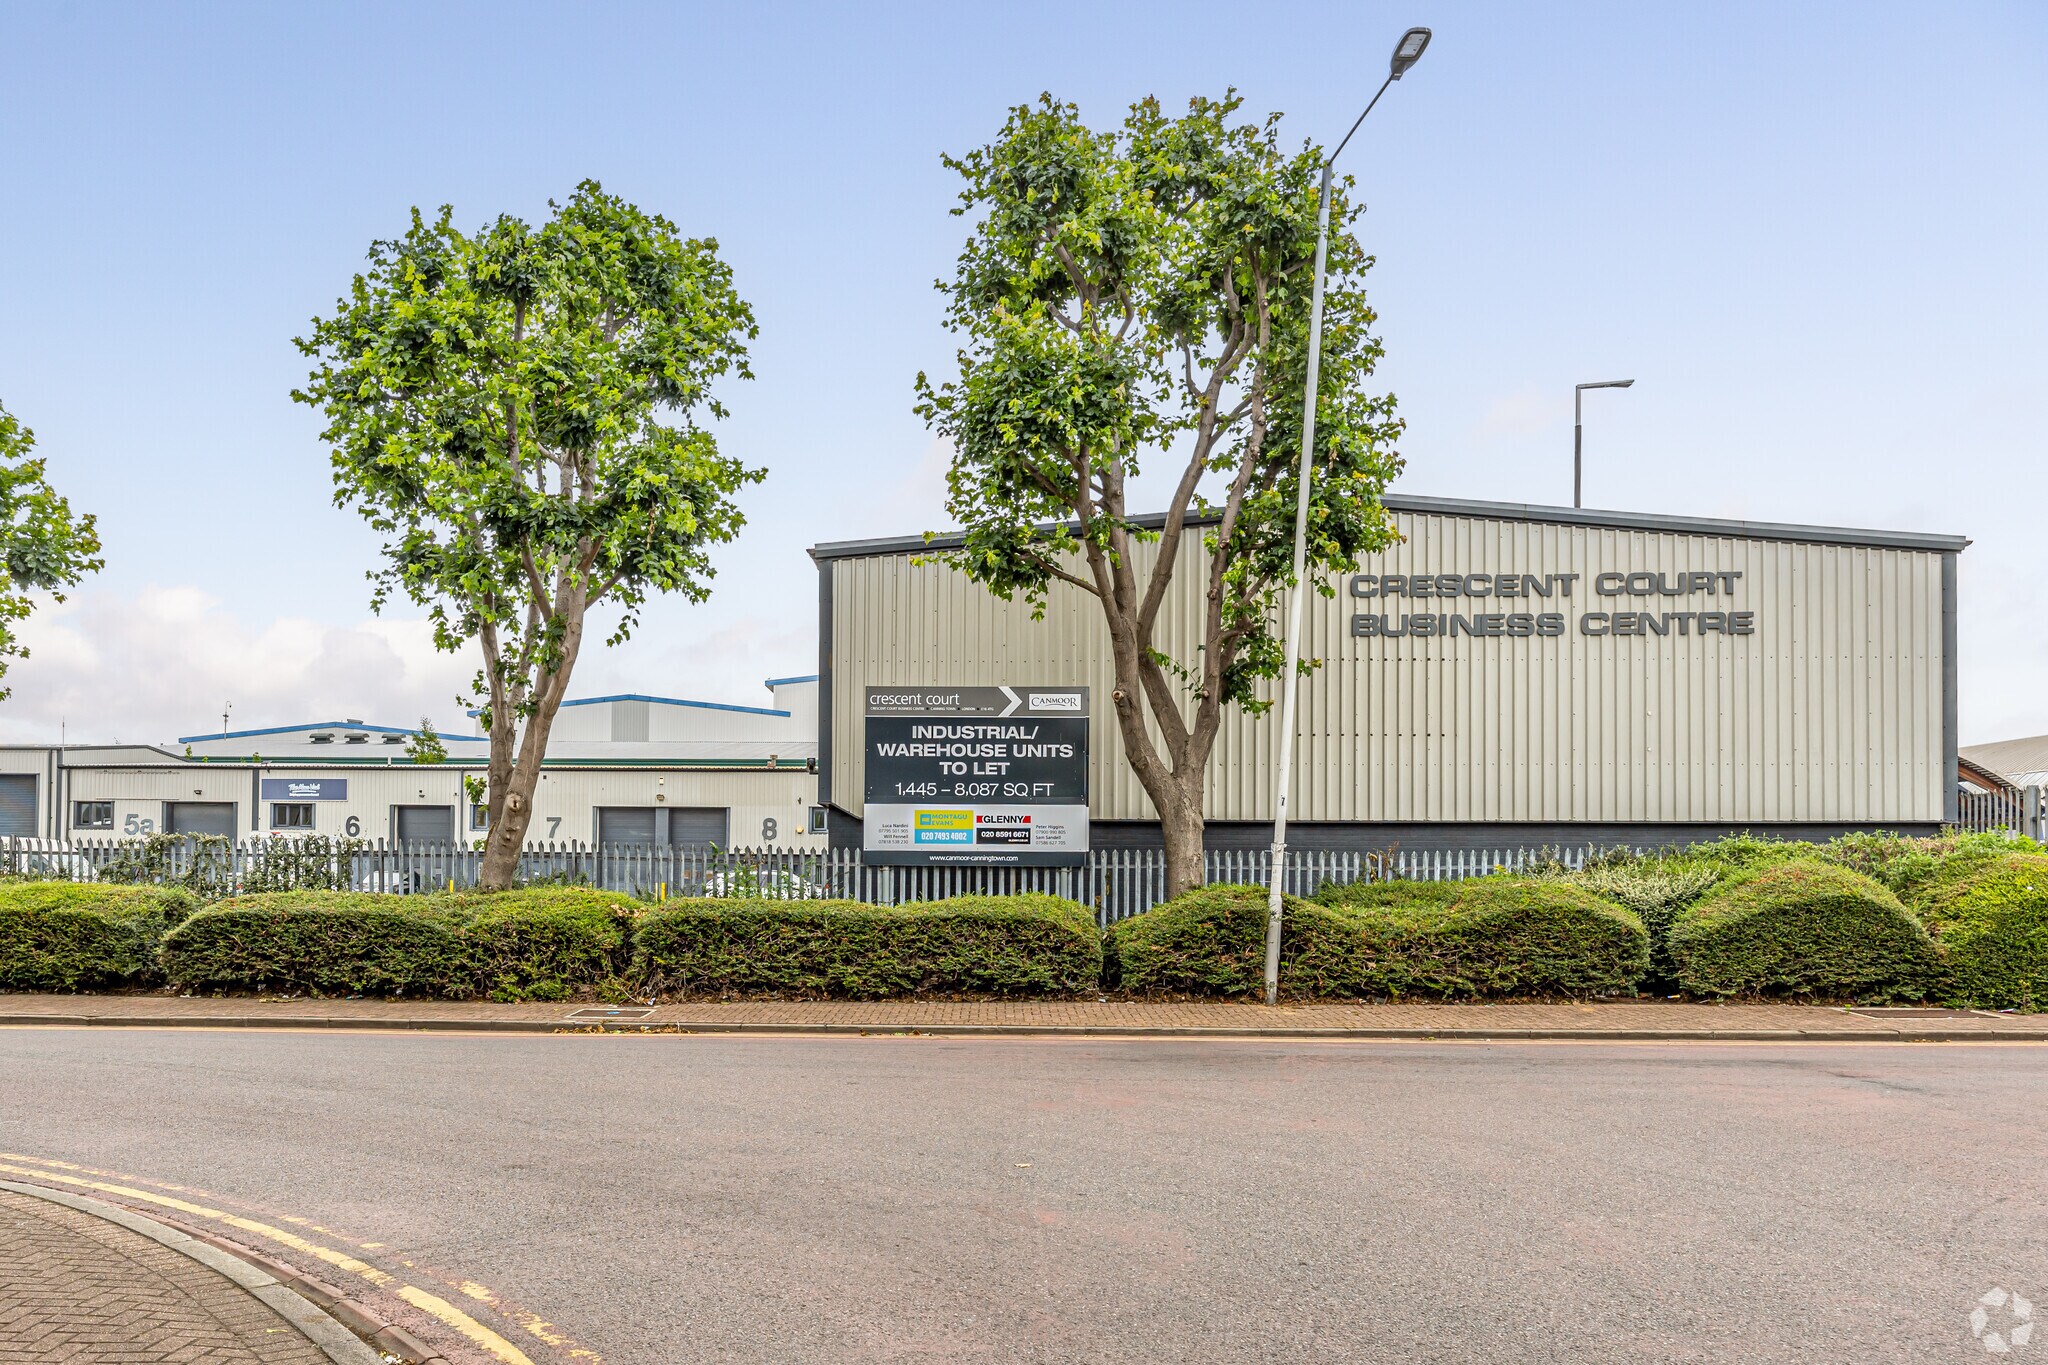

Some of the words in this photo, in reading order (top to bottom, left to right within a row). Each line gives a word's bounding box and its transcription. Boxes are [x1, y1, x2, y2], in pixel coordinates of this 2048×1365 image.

[1350, 573, 1580, 598] CRESCENT
[1596, 571, 1742, 596] COURT
[1351, 612, 1565, 637] BUSINESS
[1581, 611, 1755, 636] CENTRE
[870, 693, 922, 705] crescent
[926, 693, 960, 706] court
[912, 725, 1039, 740] INDUSTRIAL/
[877, 743, 1007, 758] WAREHOUSE
[1013, 744, 1073, 758] UNITS
[939, 762, 967, 775] TO
[973, 762, 1010, 775] LET
[895, 782, 937, 797] 1,445
[954, 783, 998, 797] 8,087
[1003, 783, 1028, 796] SQ
[1033, 783, 1054, 796] FT
[124, 814, 154, 836] 5a
[345, 815, 361, 837] 6
[546, 817, 562, 838] 7
[983, 816, 1024, 824] GLENNY
[762, 818, 777, 840] 8
[921, 832, 934, 840] 020
[934, 832, 949, 840] 7493
[951, 832, 967, 840] 4002
[929, 854, 1018, 862] www.canmoor-canningtown.com
